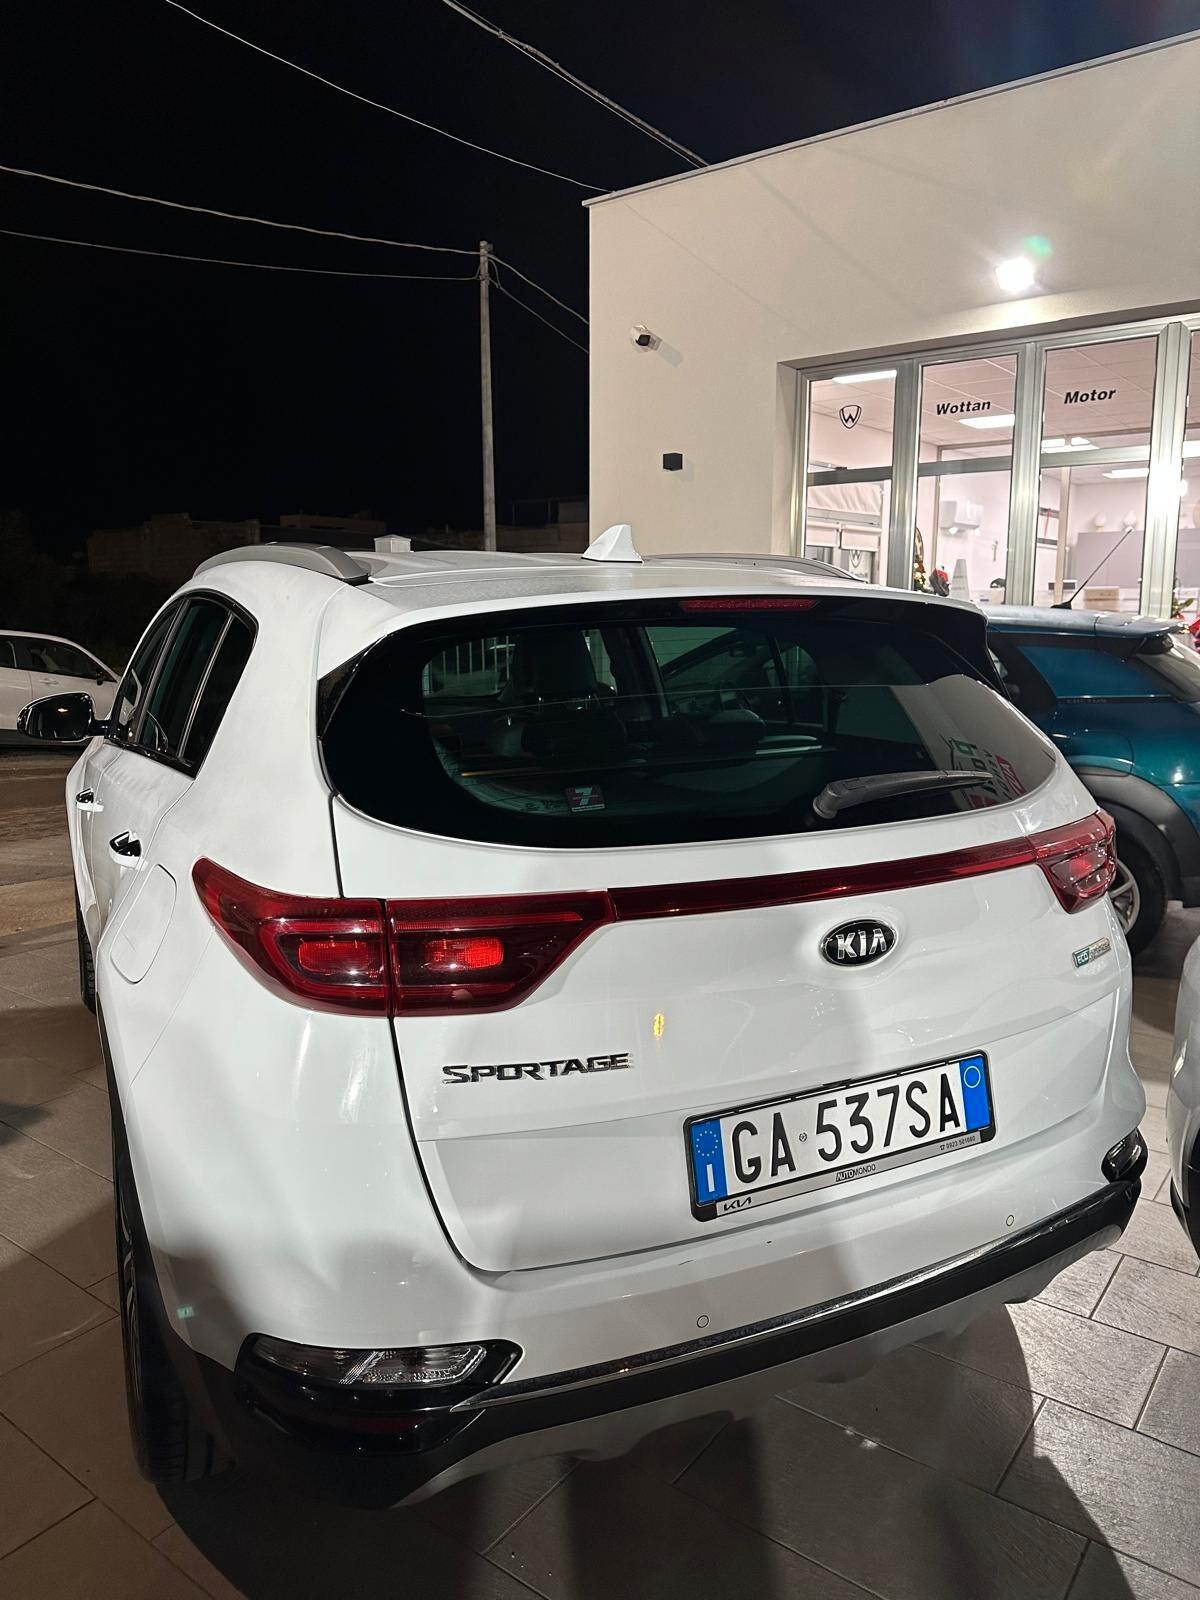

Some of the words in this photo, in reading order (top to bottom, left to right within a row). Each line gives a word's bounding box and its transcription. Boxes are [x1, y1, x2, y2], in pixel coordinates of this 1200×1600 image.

[841, 405, 860, 424] W
[936, 400, 991, 415] Wottan
[1064, 388, 1117, 404] Motor
[835, 928, 888, 960] KIA
[442, 1052, 630, 1083] SPORTAGE
[732, 1111, 797, 1185] GA
[815, 1073, 960, 1163] 537SA
[836, 1163, 877, 1182] AUTOMONDO
